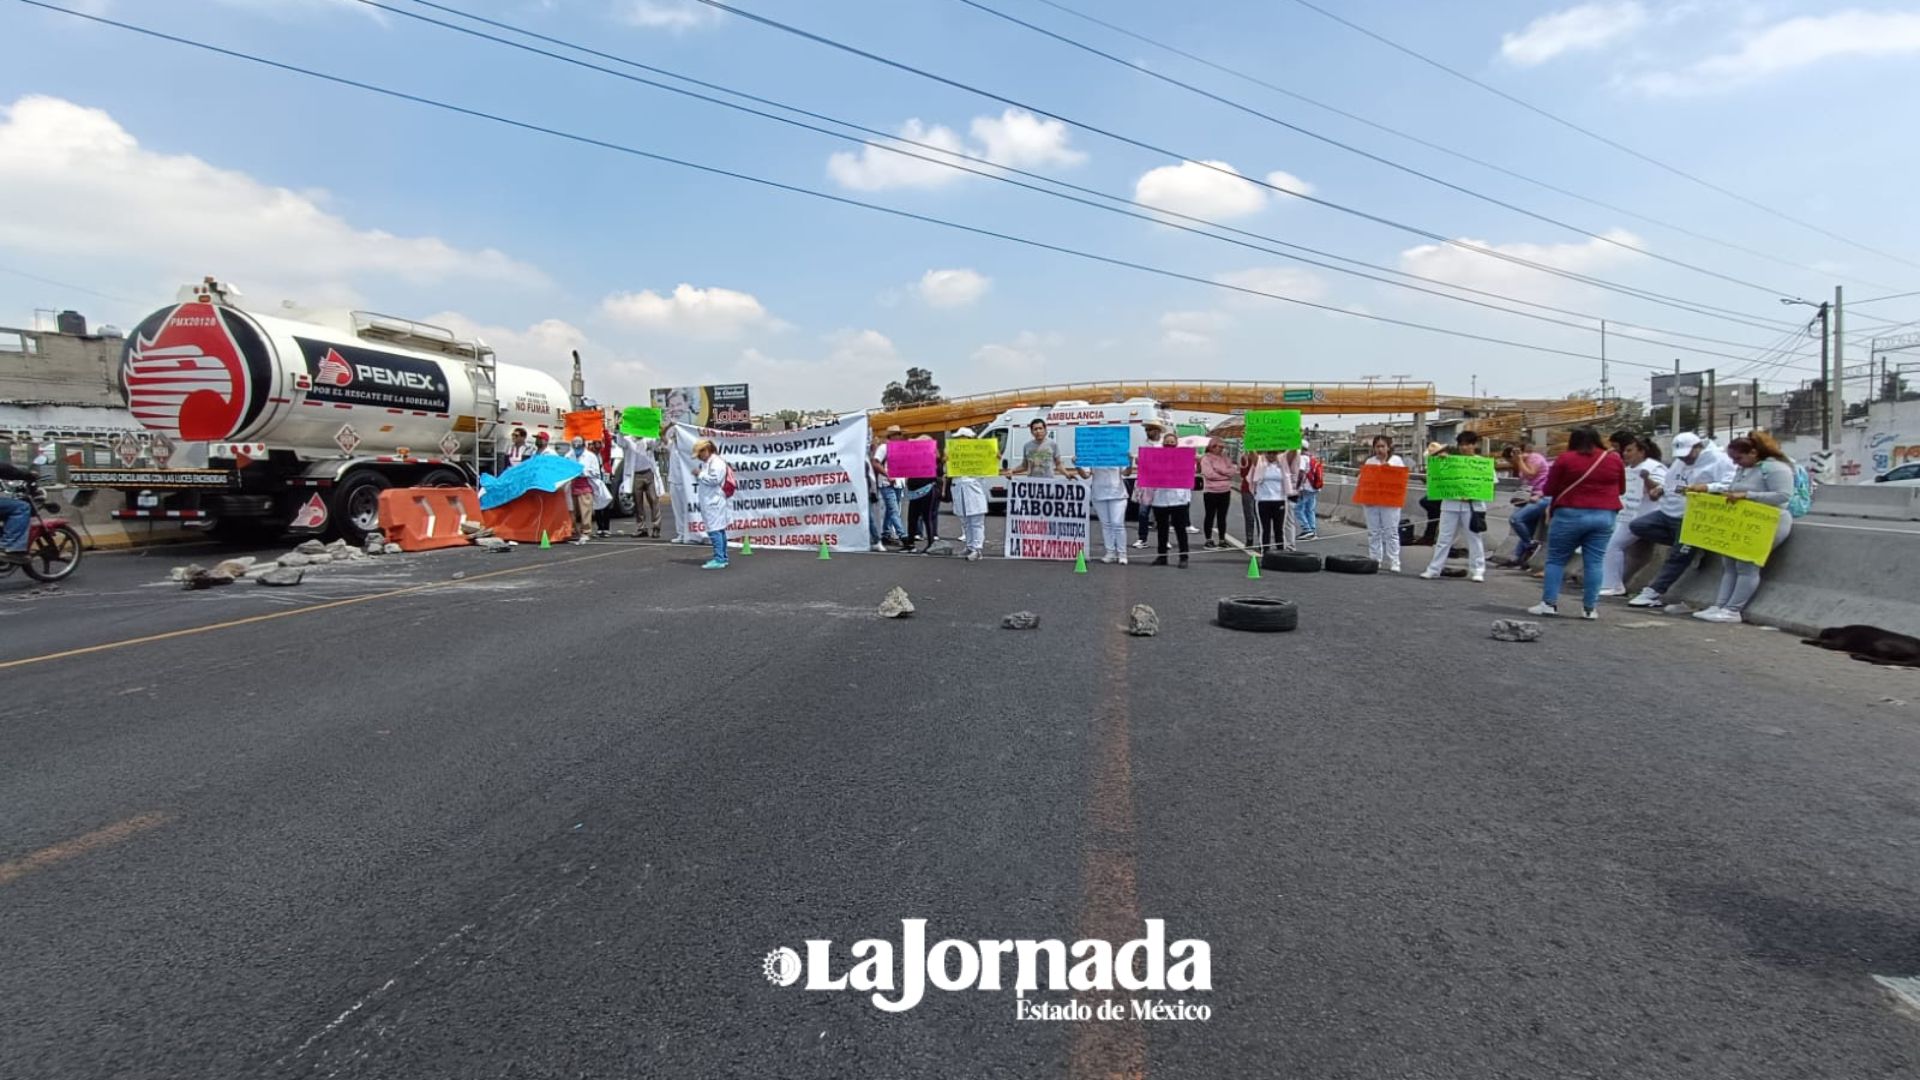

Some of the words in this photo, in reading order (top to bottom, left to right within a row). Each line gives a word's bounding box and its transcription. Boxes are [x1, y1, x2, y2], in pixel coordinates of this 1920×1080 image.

[354, 364, 435, 391] PEMEX
[313, 385, 330, 395] POR
[332, 387, 343, 397] EL
[345, 389, 382, 401] RESCATE
[383, 394, 393, 402] DE
[394, 395, 404, 403] LA
[405, 396, 446, 408] SOBERANÍA
[515, 402, 526, 411] NO
[527, 402, 551, 415] FUMAR
[1046, 410, 1105, 421] AMBULANCIA
[718, 442, 760, 455] ÍNICA
[763, 436, 835, 454] HOSPITAL
[764, 476, 793, 489] BAJO
[795, 472, 851, 487] PROTESTA
[1011, 482, 1086, 501] IGUALDAD
[733, 495, 824, 511] INCUMPLIMIENTO
[826, 494, 841, 504] DE
[844, 492, 858, 504] LA
[1010, 499, 1087, 518] LABORAL
[779, 515, 802, 527] DEL
[804, 512, 861, 526] CONTRATO
[1011, 519, 1019, 534] LA
[1019, 517, 1047, 536] VOCACIÓN
[1047, 521, 1056, 535] NO
[1057, 521, 1085, 539] JUSTIFICA
[779, 533, 838, 546] LABORALES
[1010, 538, 1020, 557] LA
[1022, 538, 1085, 559] EXPLOTACIÓN
